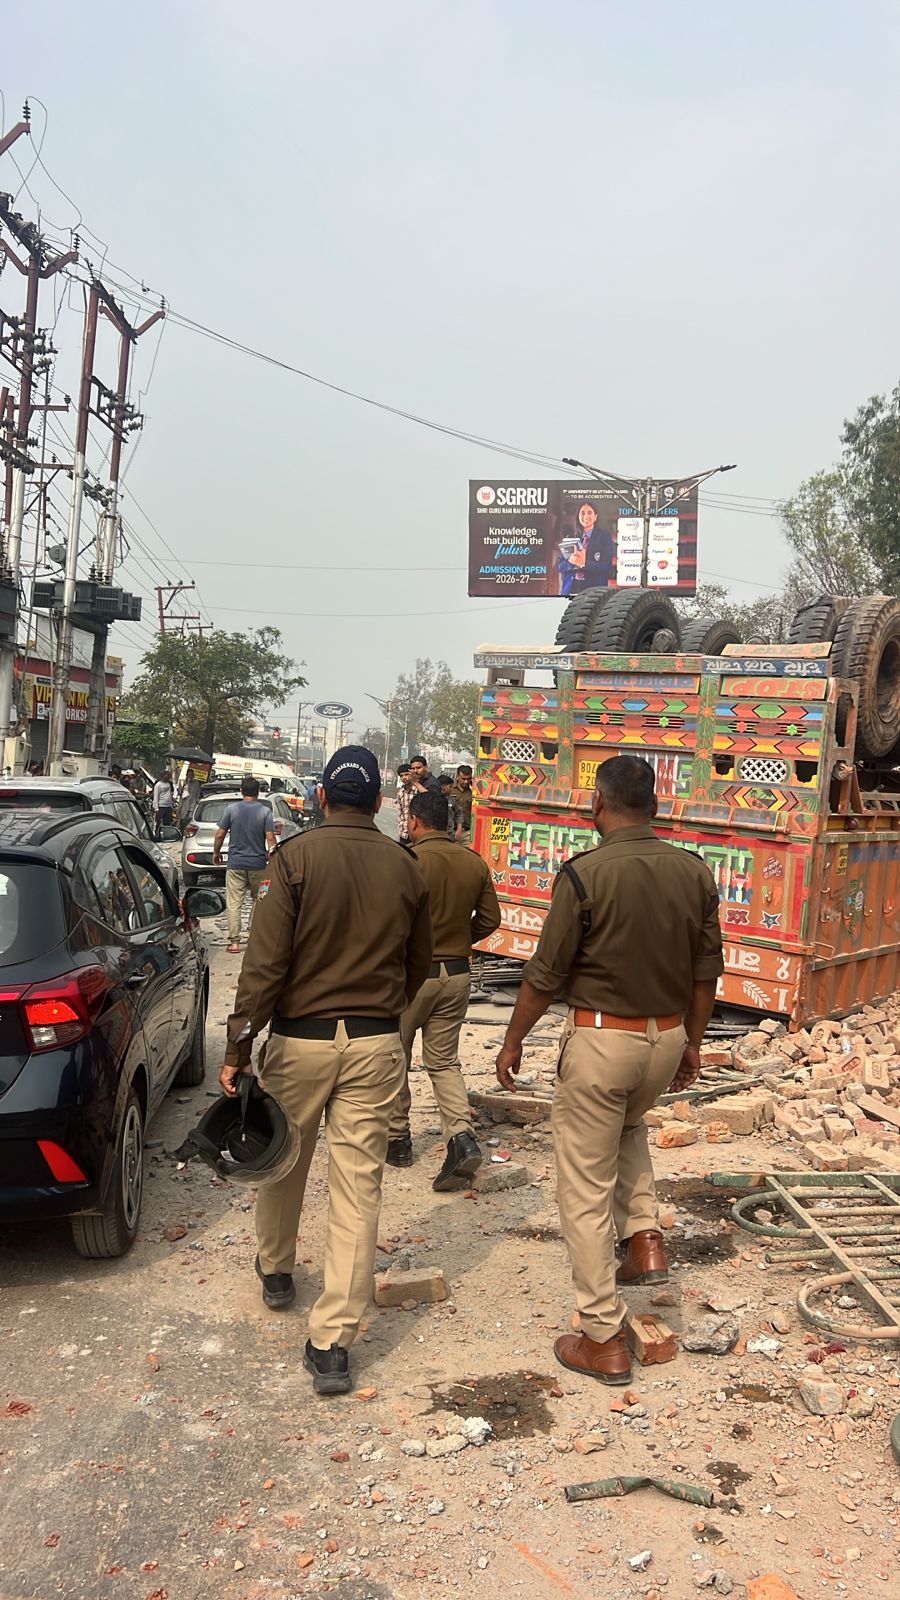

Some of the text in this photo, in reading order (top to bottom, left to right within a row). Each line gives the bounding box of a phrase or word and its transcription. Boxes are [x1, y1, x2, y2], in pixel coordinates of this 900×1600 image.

[496, 487, 548, 506] SGRRU
[489, 527, 537, 538] Knowledge
[483, 536, 543, 545] that builds the
[494, 543, 531, 560] future
[479, 565, 547, 574] ADMISSION OPEN
[495, 574, 530, 584] 2026-27
[729, 679, 823, 700] STOP
[322, 705, 343, 715] Ford
[330, 762, 371, 783] UTTARAKHAND POLICE
